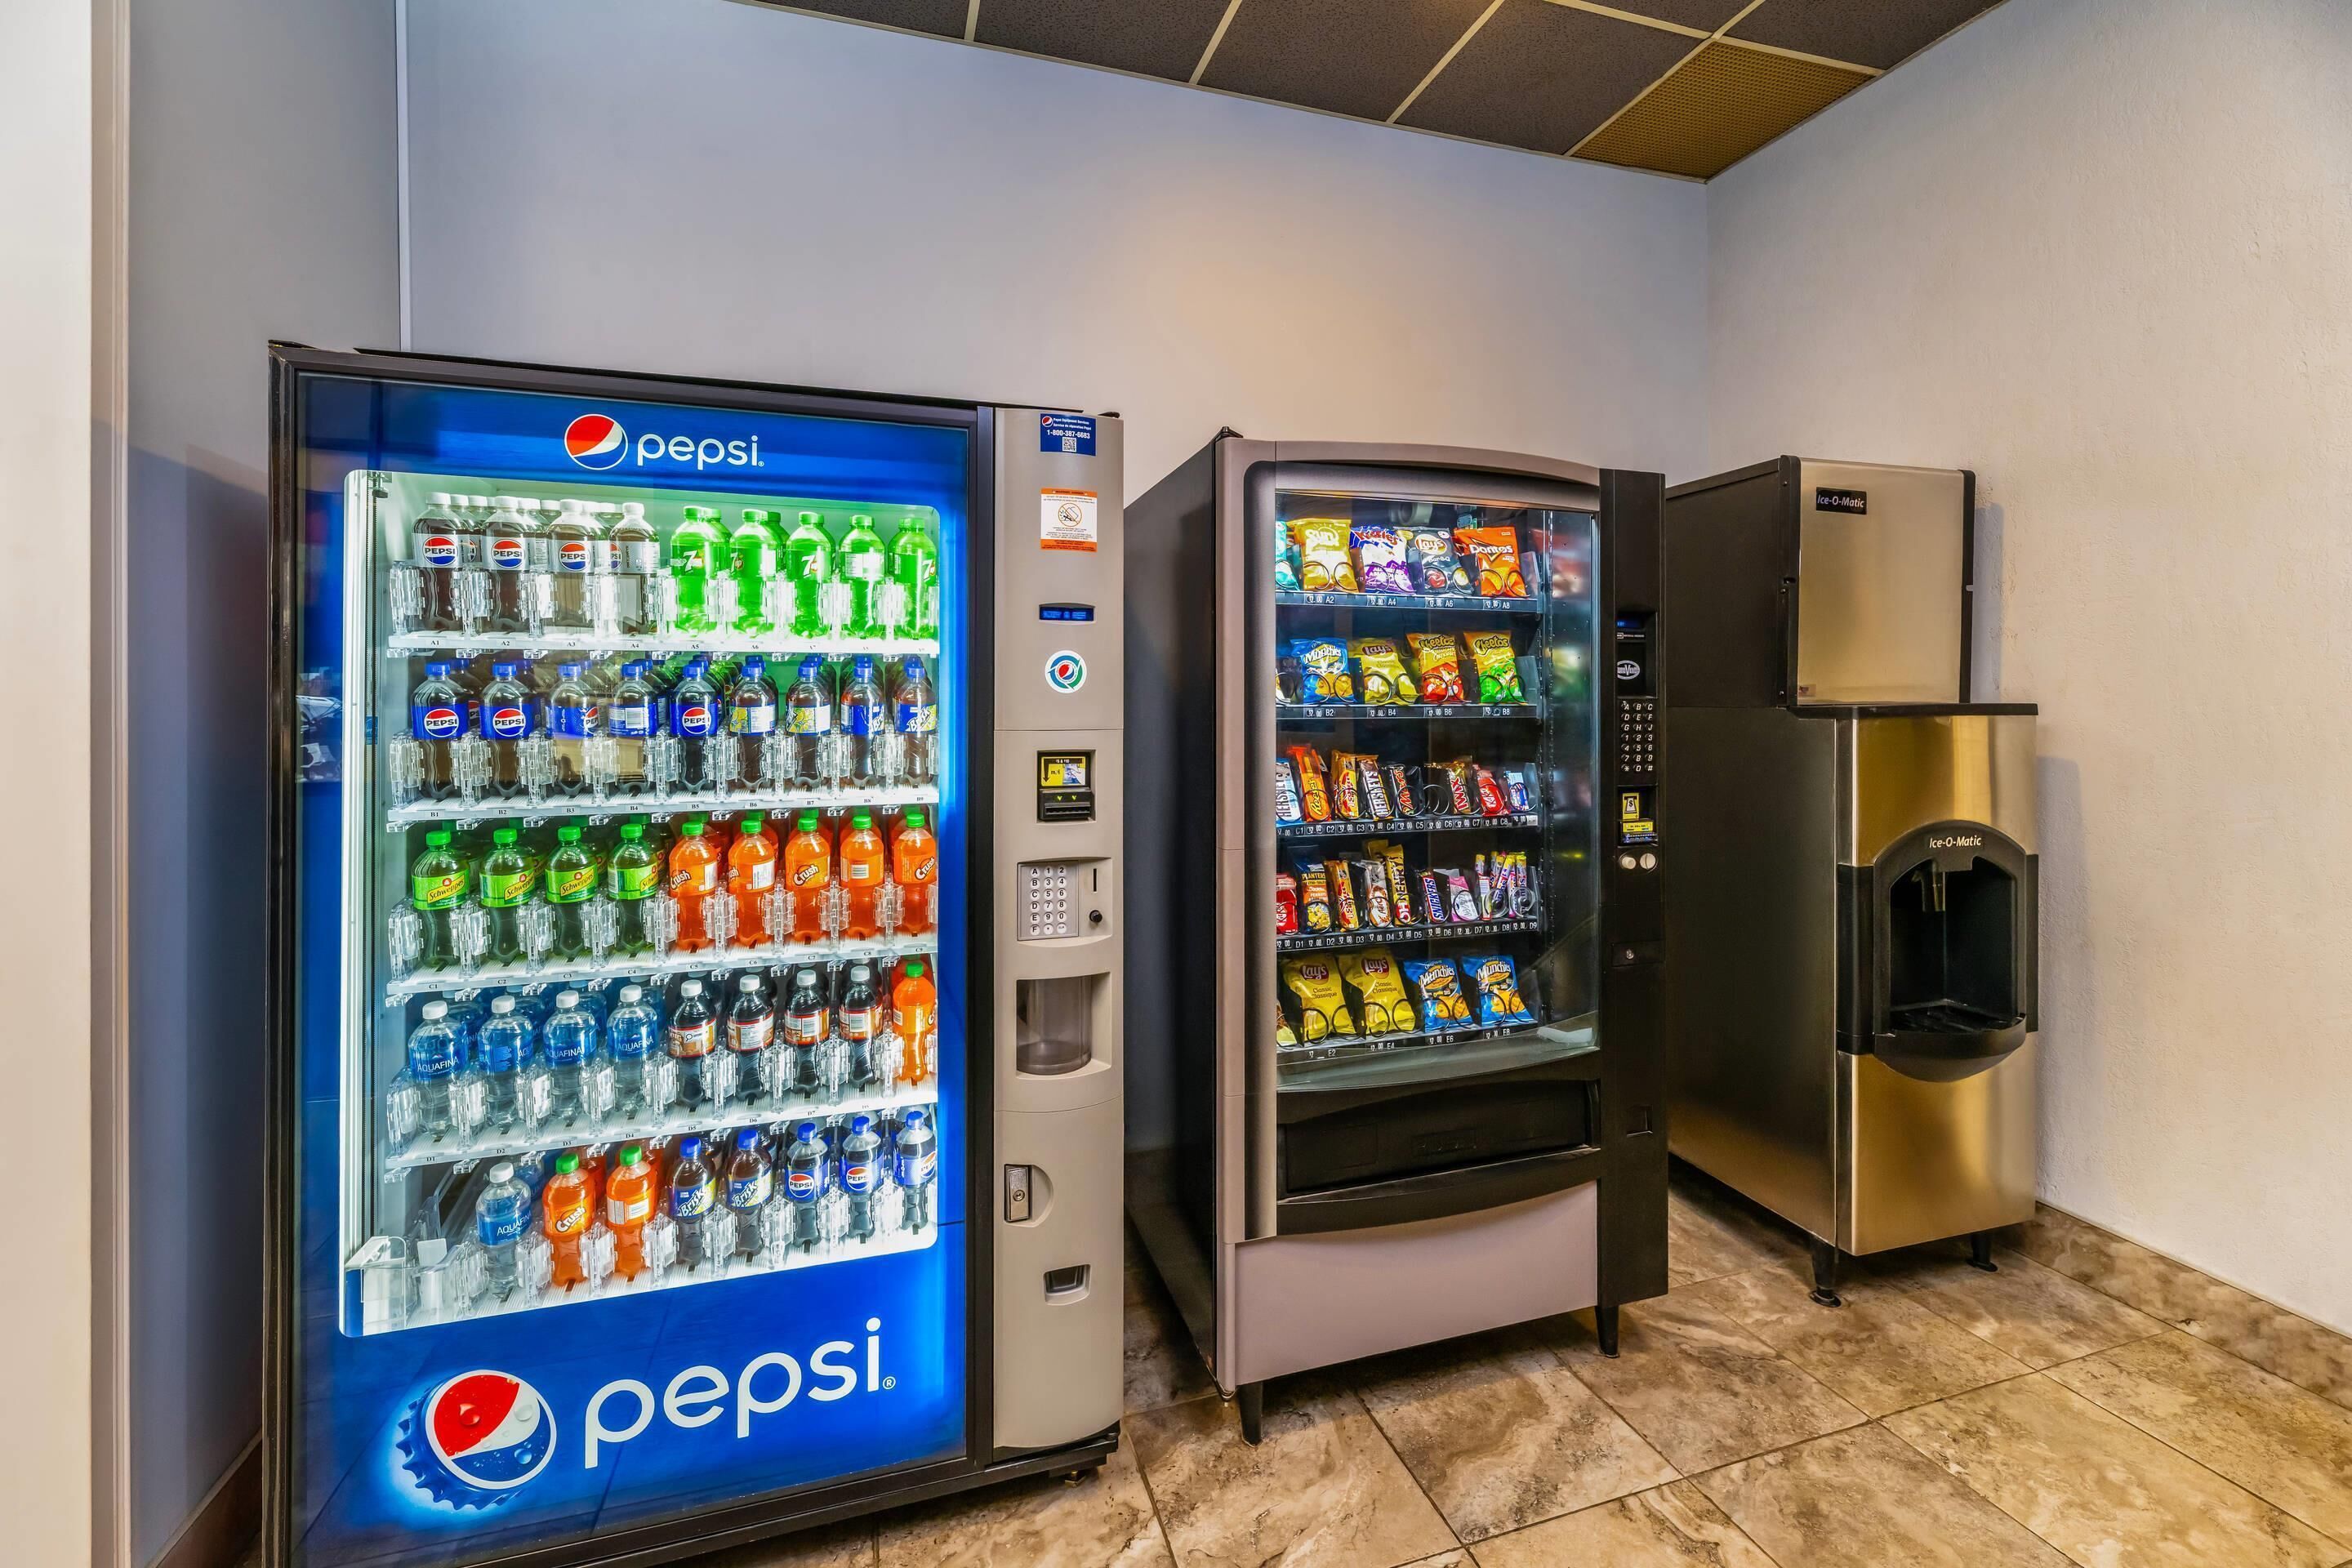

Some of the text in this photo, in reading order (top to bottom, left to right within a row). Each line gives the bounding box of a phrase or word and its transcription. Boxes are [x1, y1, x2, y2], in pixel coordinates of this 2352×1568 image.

[637, 435, 760, 470] pepsi
[1817, 494, 1865, 508] Ice-O-Matic
[1475, 635, 1510, 657] Cheetos
[426, 719, 457, 727] PEPSI
[1929, 835, 1982, 848] Ice-O-Matic
[562, 874, 593, 893] Schweppes
[792, 864, 819, 887] Crush
[430, 880, 464, 900] Schweppes
[506, 875, 534, 897] Schwepp
[1424, 879, 1445, 921] SNICKERS
[1529, 921, 1537, 929] D9
[1326, 938, 1334, 946] D2
[1414, 931, 1423, 939] D5
[1419, 965, 1455, 987] Munchies
[1478, 962, 1511, 980] Munchies
[416, 1056, 459, 1072] AQUAFINA
[732, 1180, 758, 1207] Brisk
[789, 1181, 813, 1189] PEPSI
[555, 1206, 586, 1232] Crush
[584, 1316, 880, 1469] pepsi
